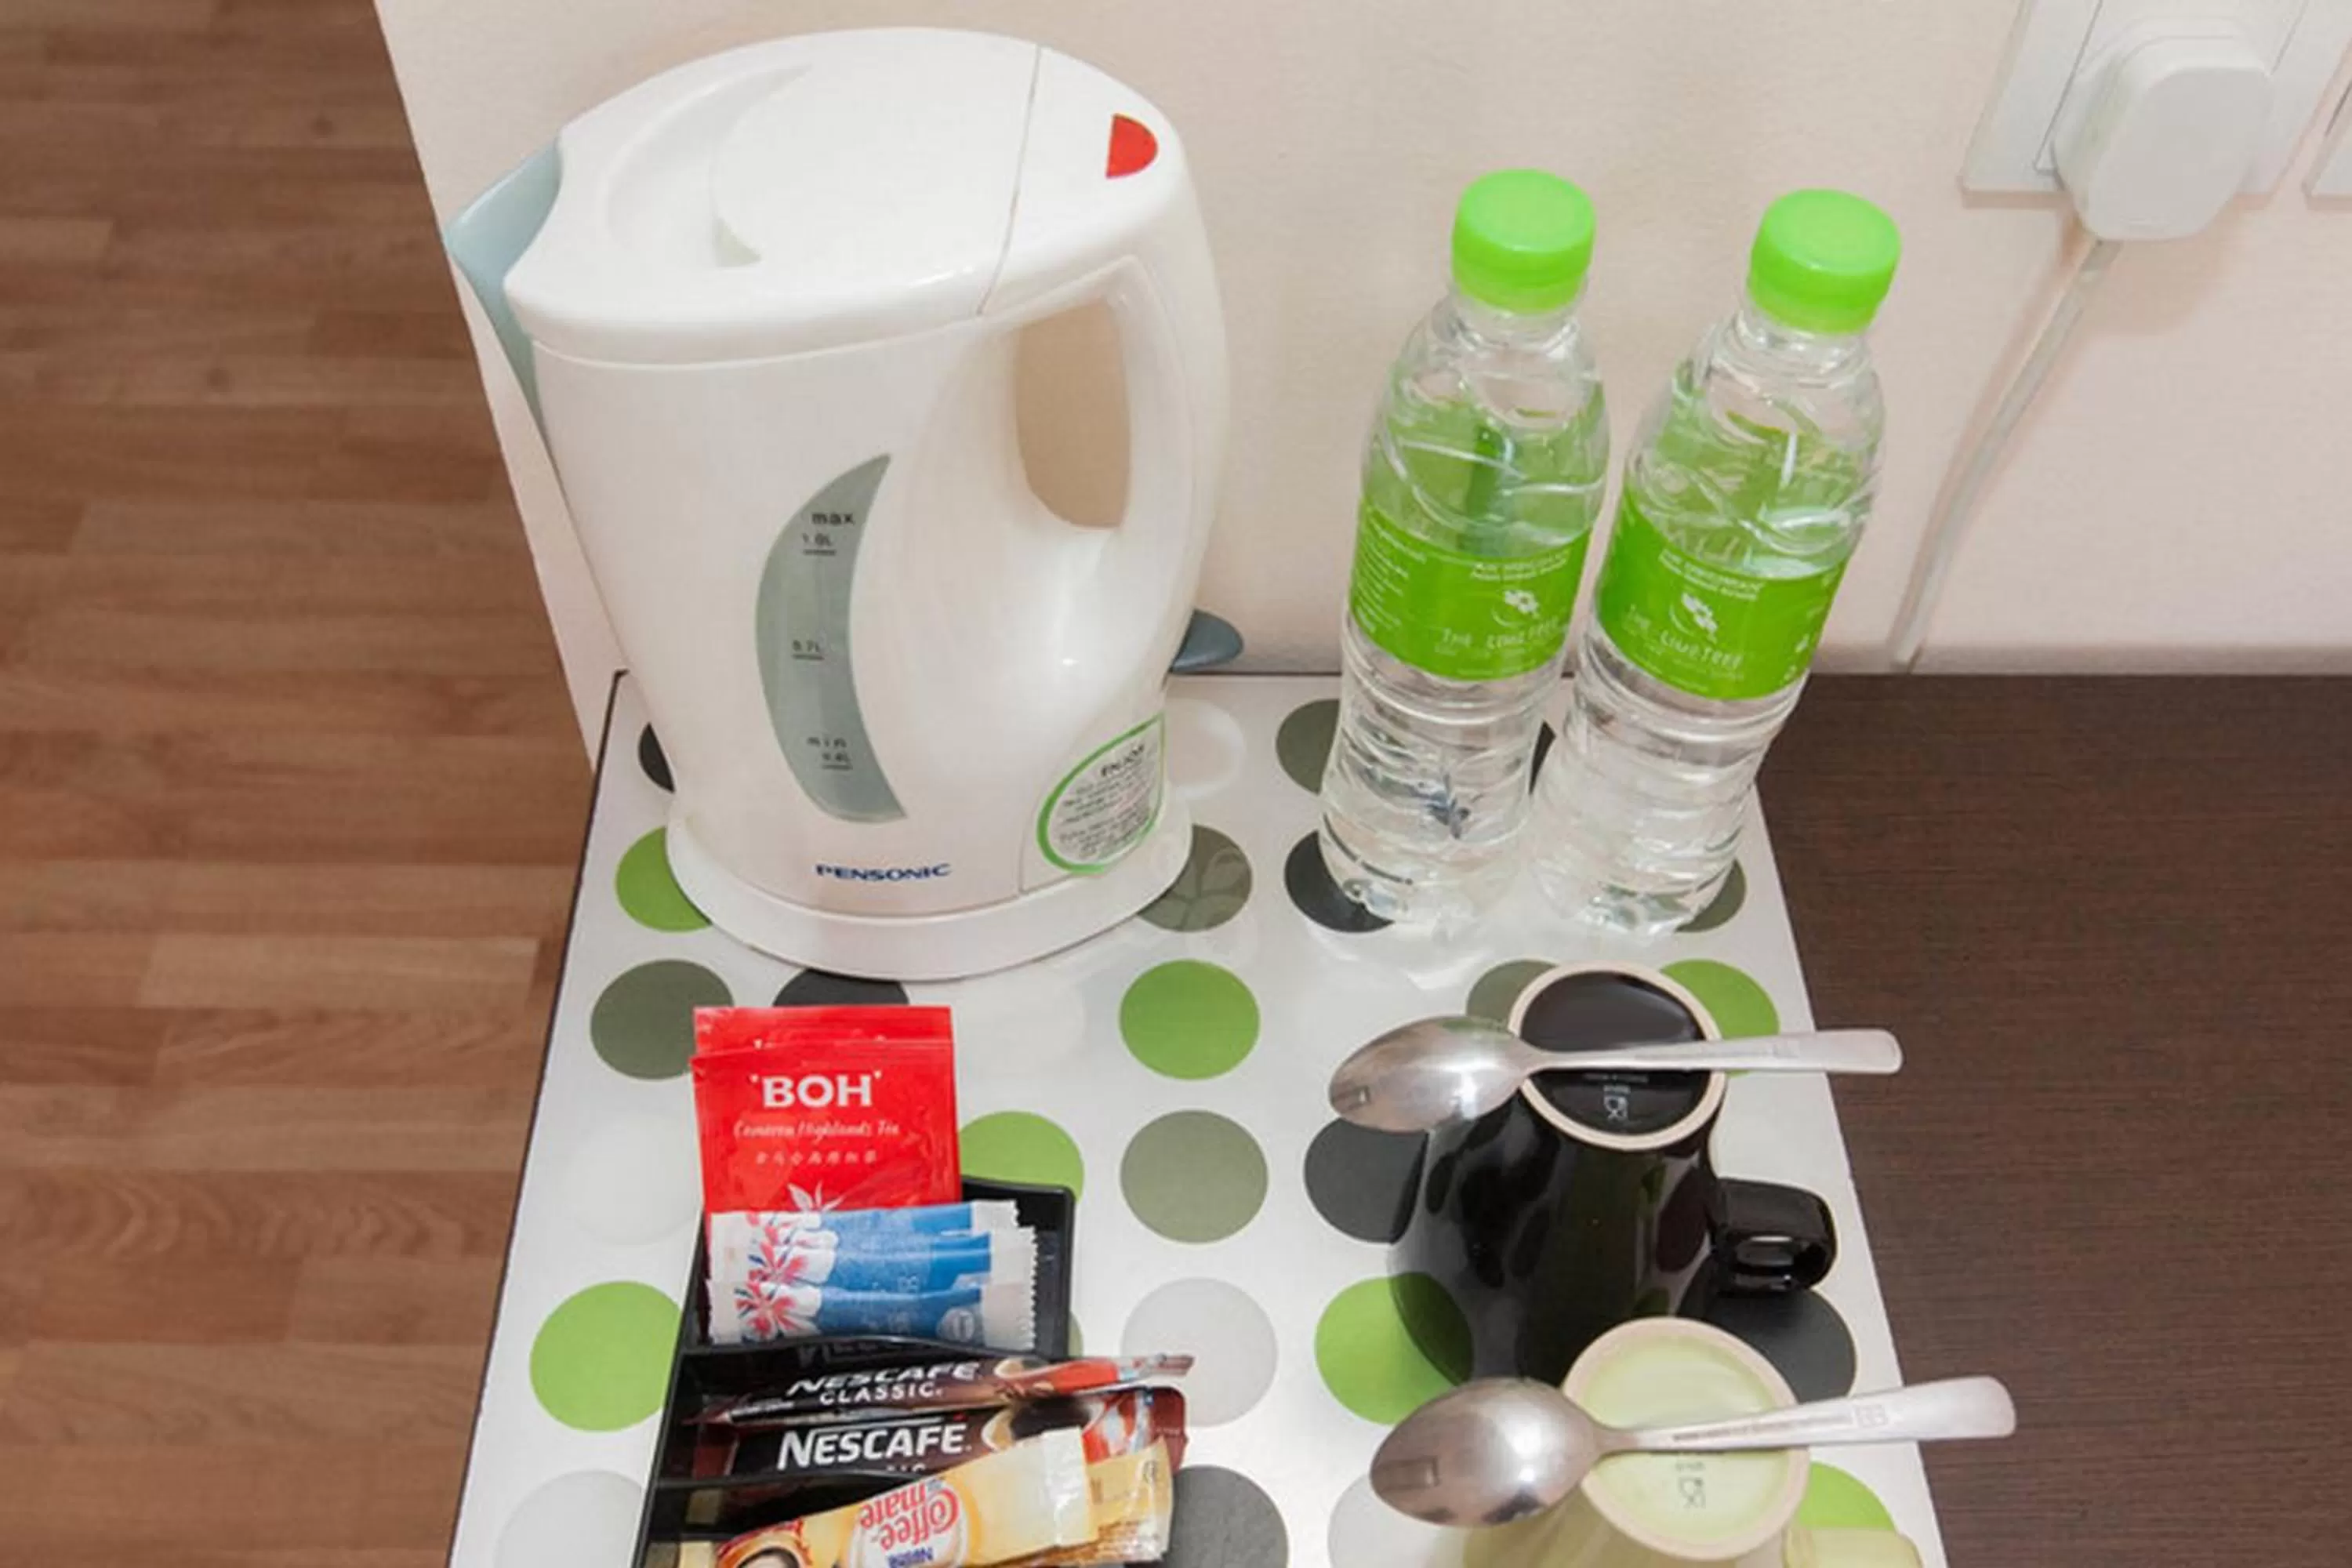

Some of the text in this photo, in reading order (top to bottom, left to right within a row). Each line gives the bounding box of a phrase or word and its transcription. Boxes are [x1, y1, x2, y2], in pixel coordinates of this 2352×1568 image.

[811, 512, 855, 526] max
[816, 863, 952, 881] PENSONIC
[859, 1483, 927, 1530] mate
